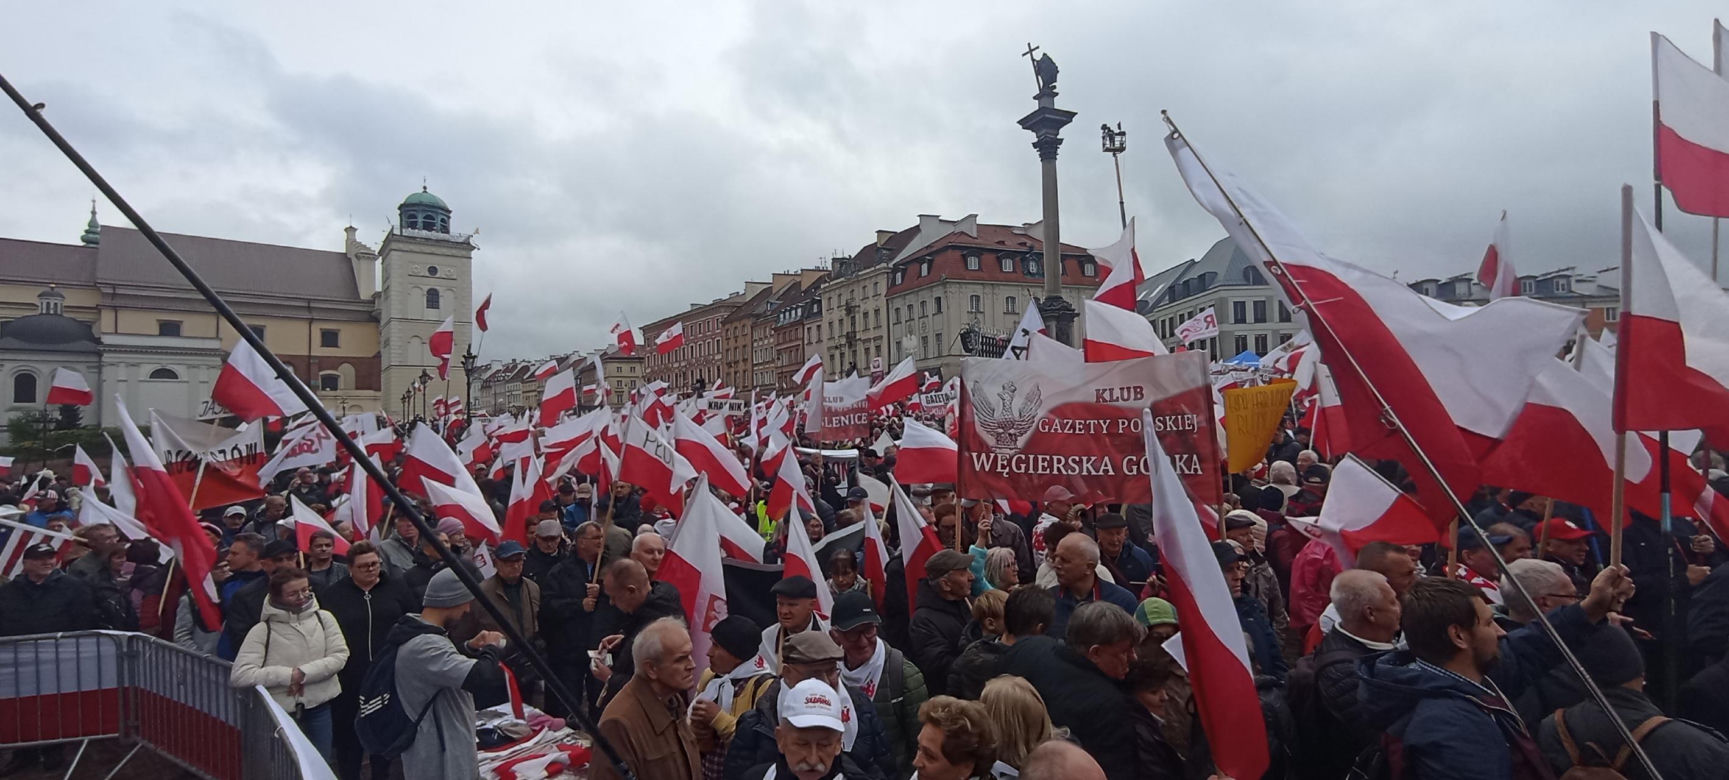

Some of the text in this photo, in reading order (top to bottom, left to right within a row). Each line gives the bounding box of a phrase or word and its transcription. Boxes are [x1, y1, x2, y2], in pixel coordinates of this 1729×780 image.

[1095, 386, 1145, 404] KLUB
[708, 400, 743, 412] KRANIK
[822, 413, 868, 428] LENICE
[1038, 414, 1197, 434] GAZETY POSKIEJ
[972, 452, 1203, 477] WĘGIERSKA GKA
